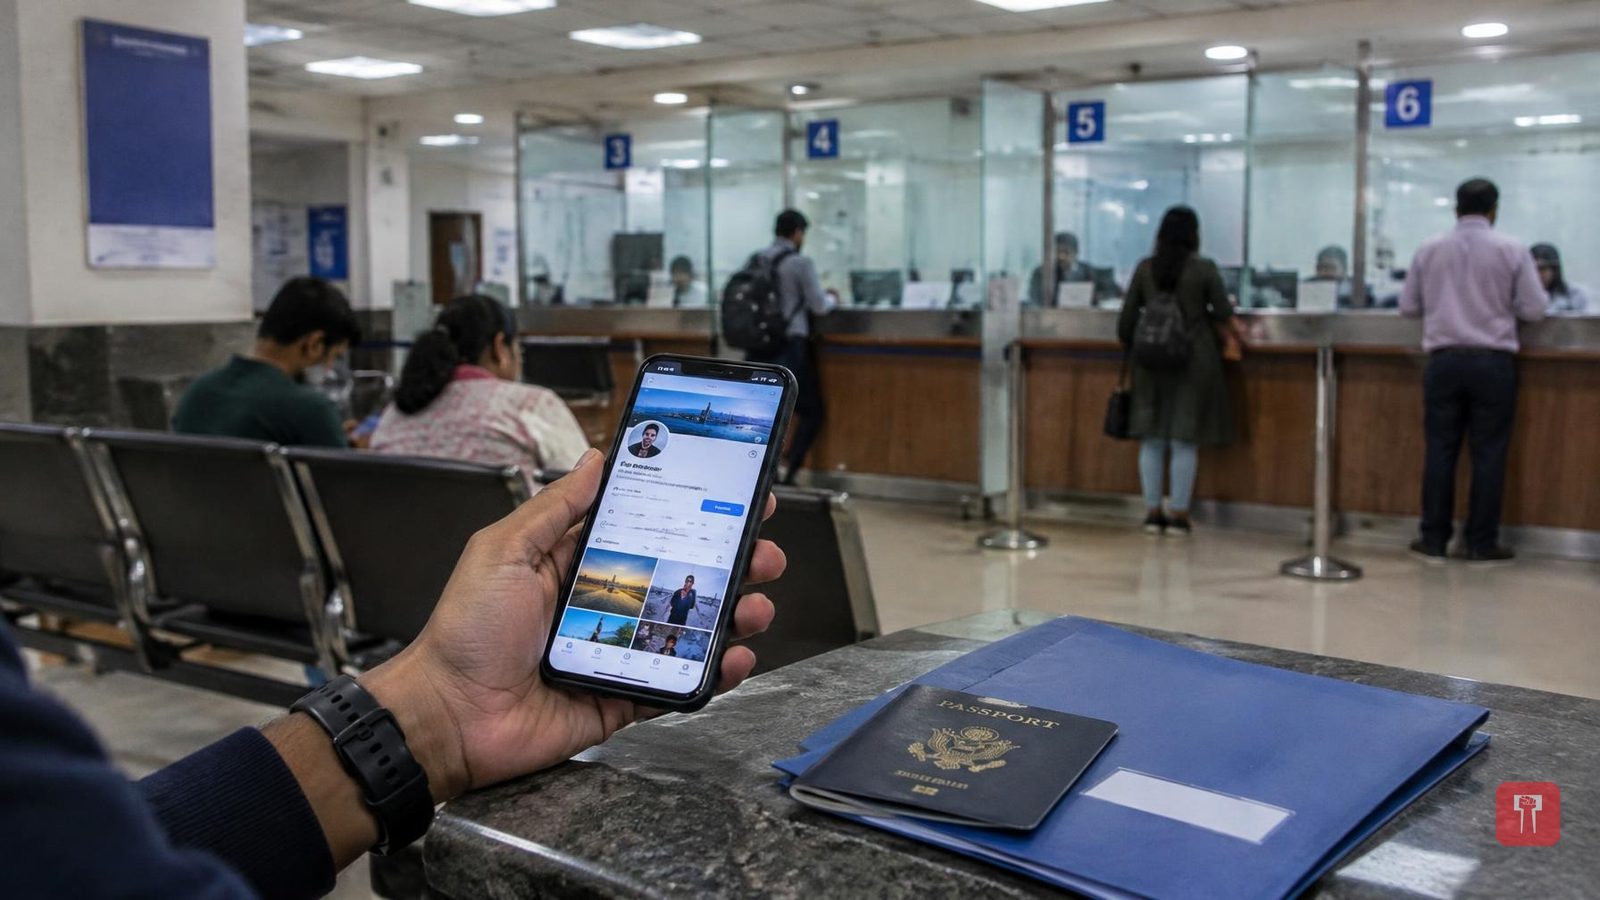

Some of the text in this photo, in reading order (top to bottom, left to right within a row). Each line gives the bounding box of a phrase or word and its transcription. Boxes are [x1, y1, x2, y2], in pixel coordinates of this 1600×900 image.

[1396, 86, 1421, 121] 6
[1075, 107, 1097, 139] 5
[610, 139, 626, 165] 3
[813, 125, 831, 153] 4
[936, 699, 1060, 729] PASSPORT
